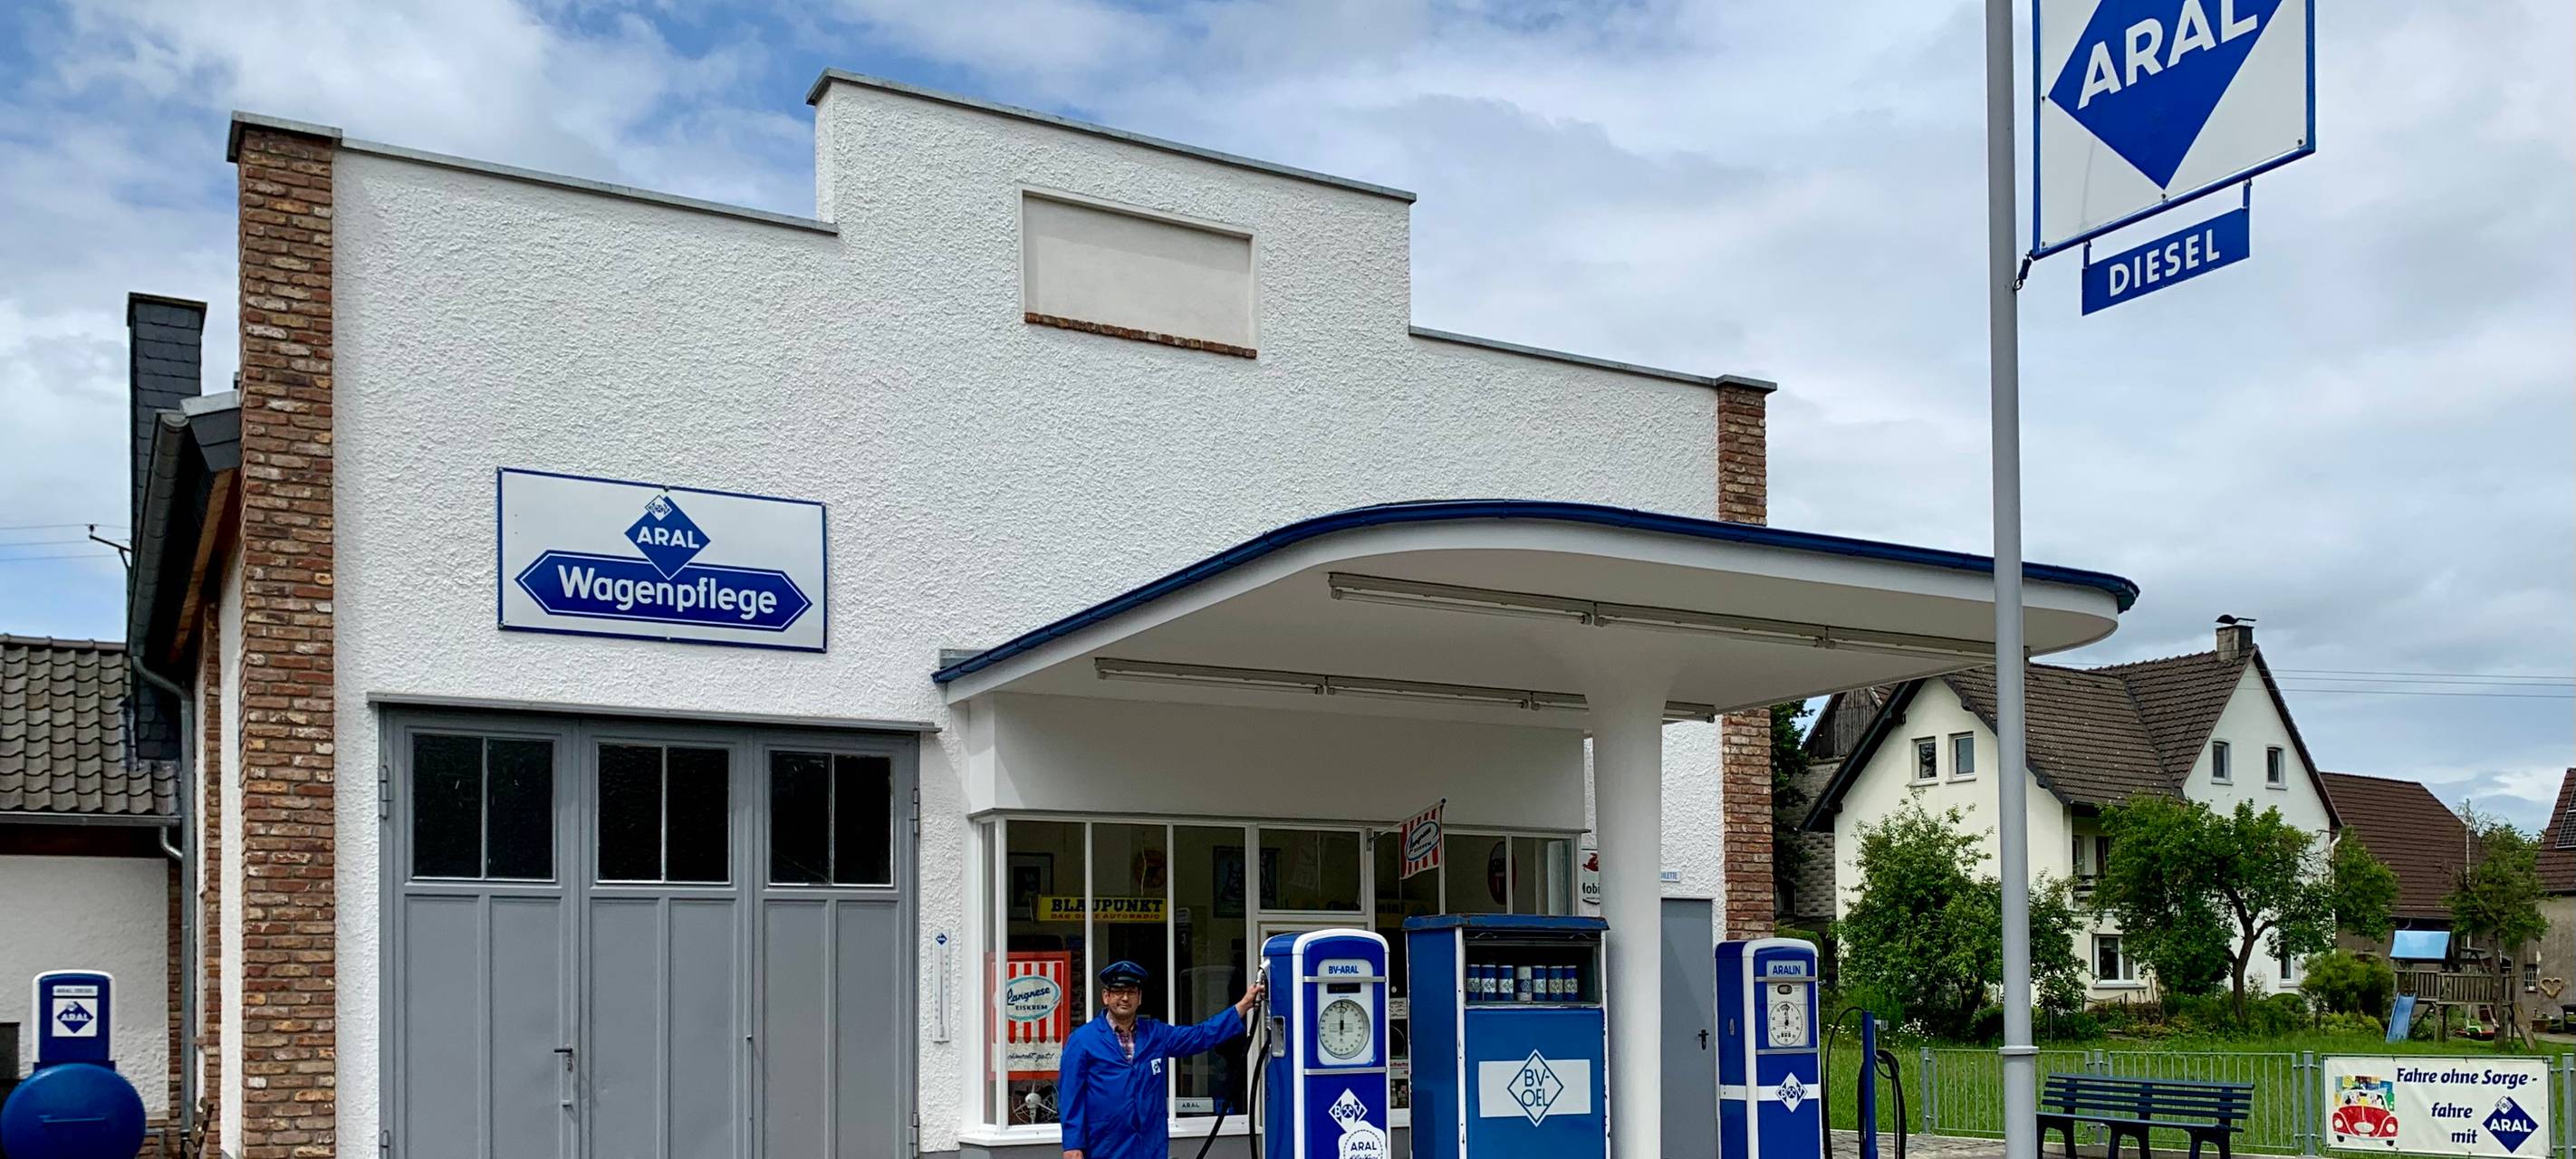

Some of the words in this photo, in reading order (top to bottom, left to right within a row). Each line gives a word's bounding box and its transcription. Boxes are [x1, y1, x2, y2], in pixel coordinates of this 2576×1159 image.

[2077, 0, 2258, 110] ARAL
[2109, 229, 2220, 297] DIESEL
[636, 526, 700, 549] ARAL
[557, 564, 777, 620] Wagenpflege
[1051, 898, 1163, 913] BLAUPUNKT
[1328, 965, 1359, 974] BV-ARAL
[1773, 965, 1801, 975] ARALIN
[1007, 987, 1051, 1006] Langnese
[61, 1013, 90, 1021] ARAL
[1524, 1068, 1550, 1087] BV-
[2397, 1068, 2437, 1083] Fahre
[2441, 1068, 2478, 1084] ohne
[2482, 1069, 2528, 1089] Sorge
[1522, 1088, 1549, 1106] OEL
[2431, 1102, 2473, 1118] fahre
[2490, 1119, 2533, 1132] ARAL
[2451, 1129, 2478, 1144] mit
[1350, 1141, 1378, 1151] ARAL
